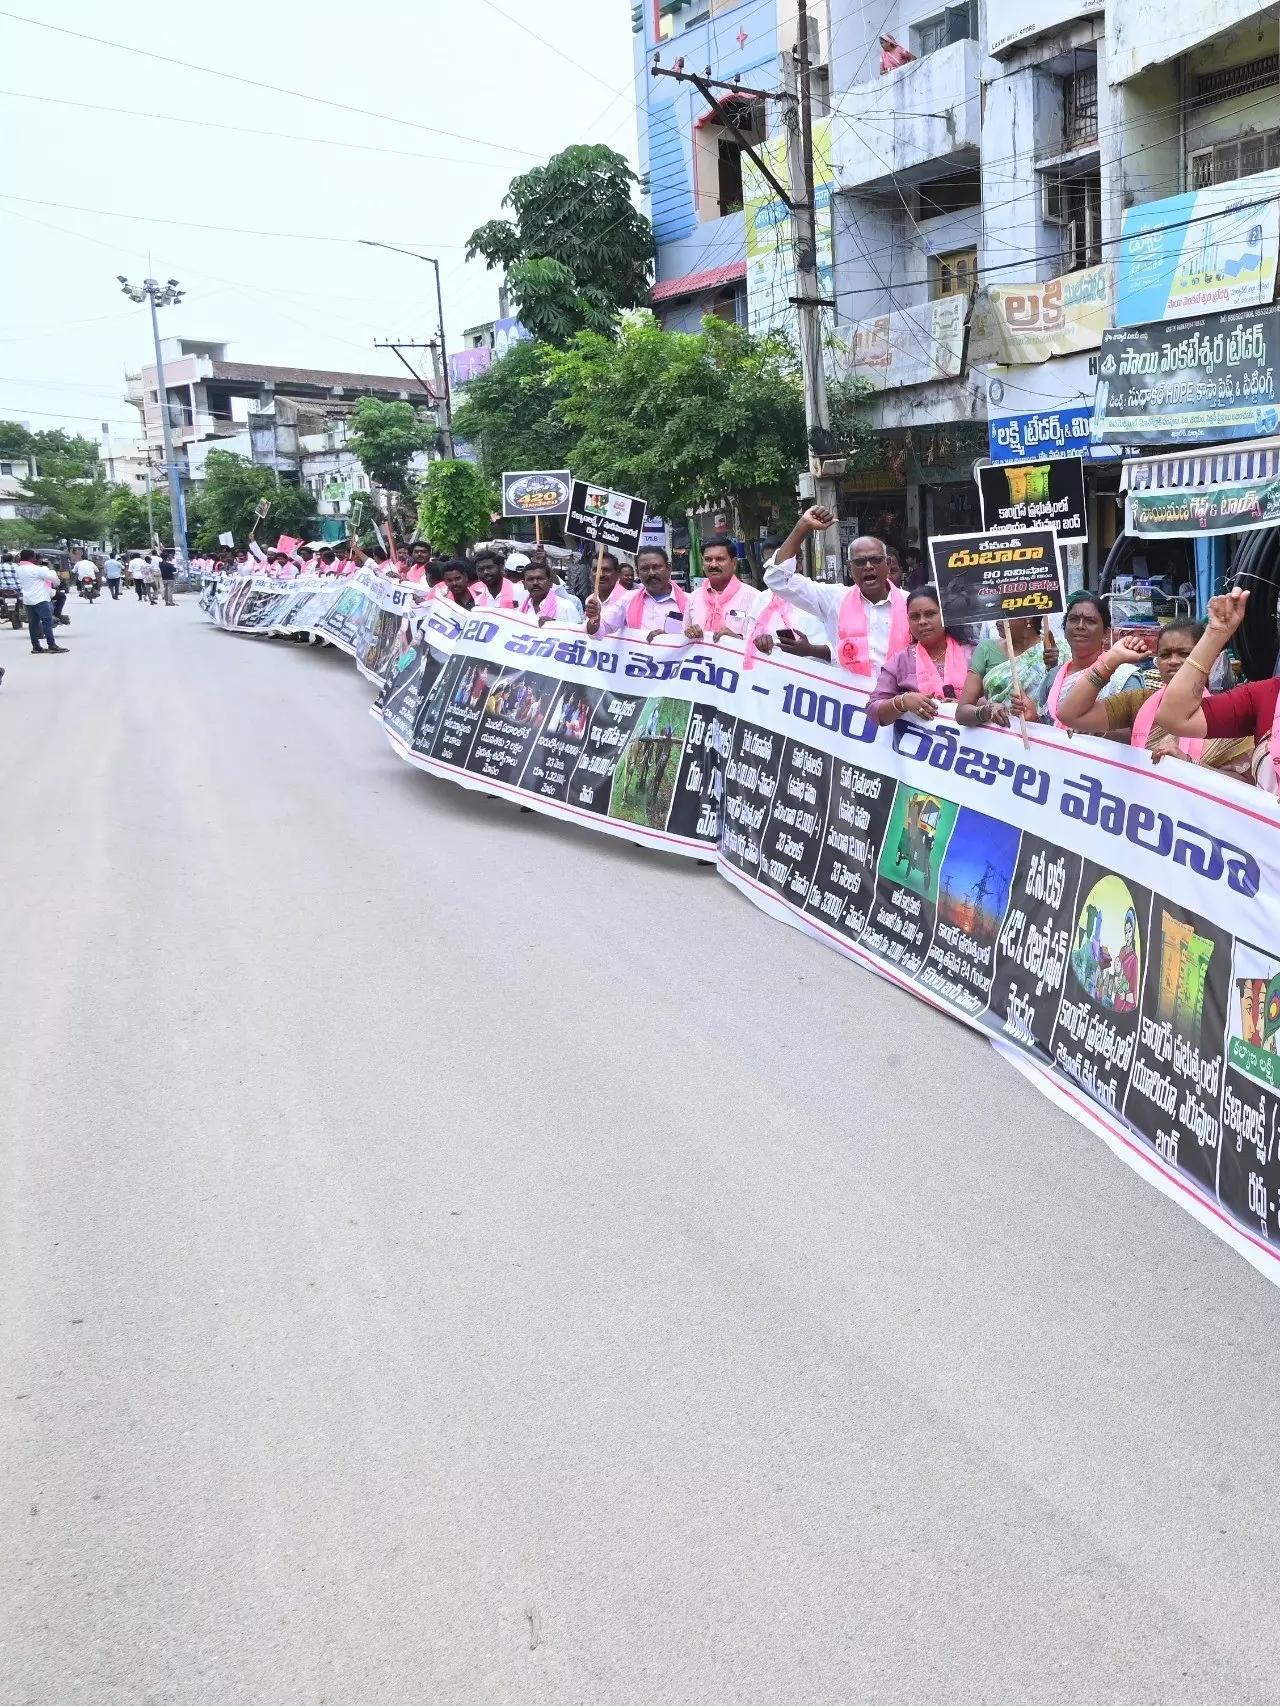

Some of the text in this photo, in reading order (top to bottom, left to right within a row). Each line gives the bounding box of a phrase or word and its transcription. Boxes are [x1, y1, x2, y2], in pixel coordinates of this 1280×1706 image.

[1119, 324, 1267, 375] సాయి వెంకటేశ్వర ట్రేడర్స్
[1024, 415, 1065, 446] ట్రేడర్స్
[517, 491, 558, 504] 420
[1063, 514, 1081, 530] బంద్
[979, 538, 1022, 551] రేవంత్
[948, 546, 1044, 568] దుబారా
[1004, 566, 1049, 577] నిమిషాల
[503, 633, 620, 674] హామీల
[624, 650, 740, 694] మోసం
[892, 720, 1051, 806] రోజుల
[1060, 773, 1262, 899] పాలనా
[1140, 1015, 1222, 1098] కాంగ్రెస్ ప్రభుత్వంలో
